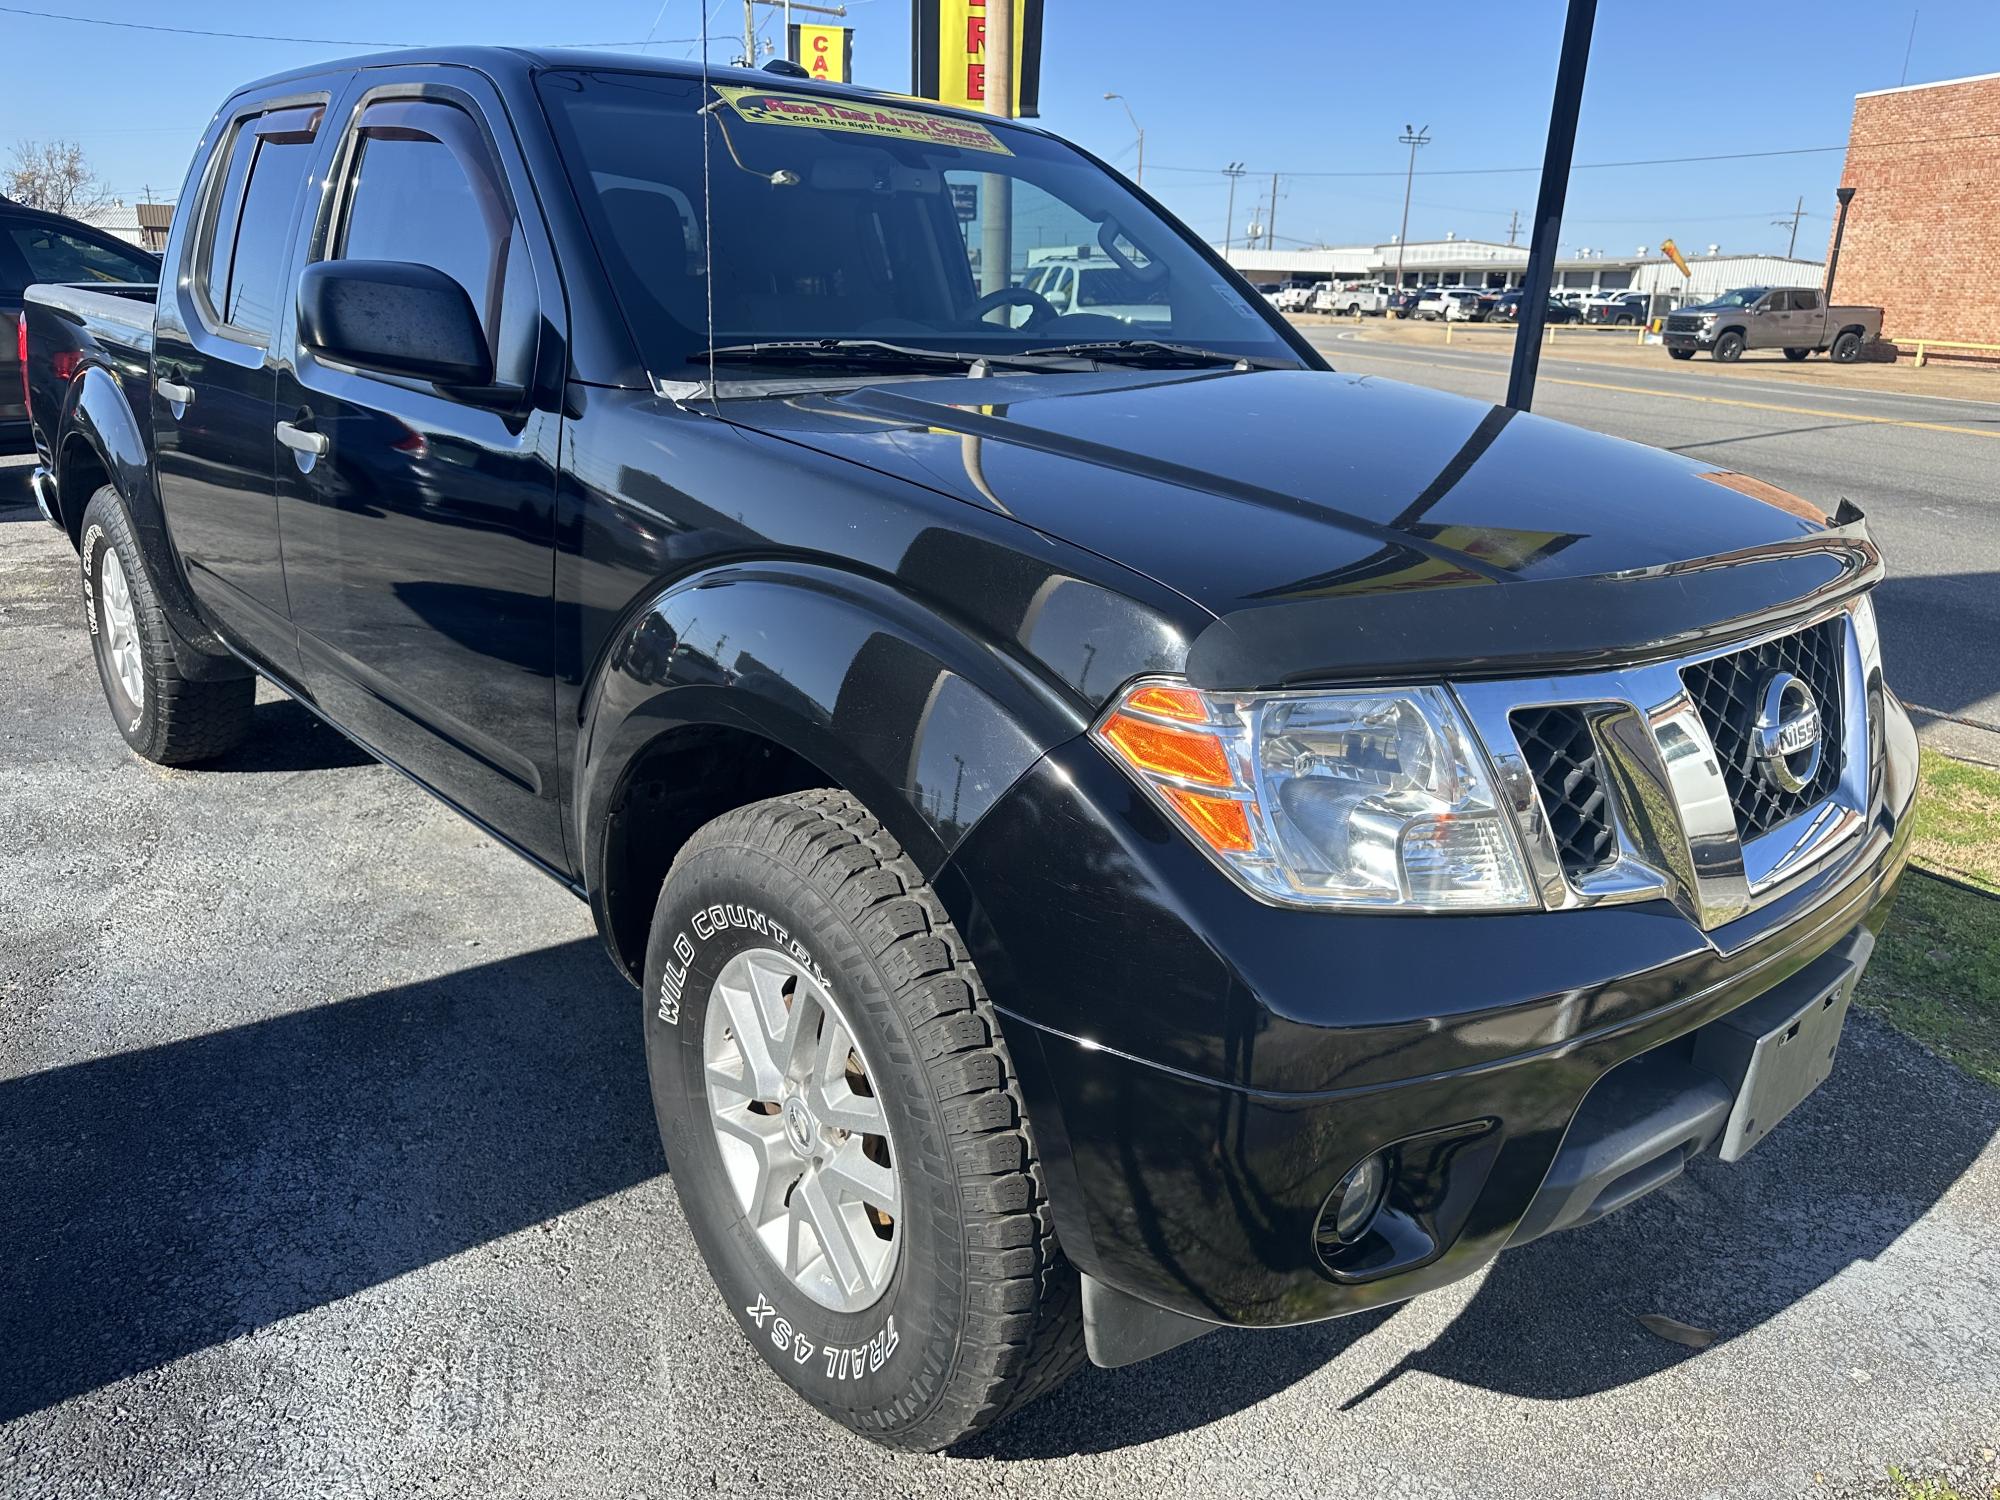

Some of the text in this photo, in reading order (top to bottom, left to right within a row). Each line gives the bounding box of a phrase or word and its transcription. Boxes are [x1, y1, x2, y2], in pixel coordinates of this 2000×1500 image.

[764, 98, 822, 115] RIDE
[816, 103, 874, 122] TIME
[875, 112, 929, 130] AUTO
[793, 115, 902, 134] Get On The Right Track
[83, 578, 99, 635] WILD
[658, 904, 833, 1025] WILD COUNTRY
[746, 1292, 900, 1380] TRAIL 4SX
